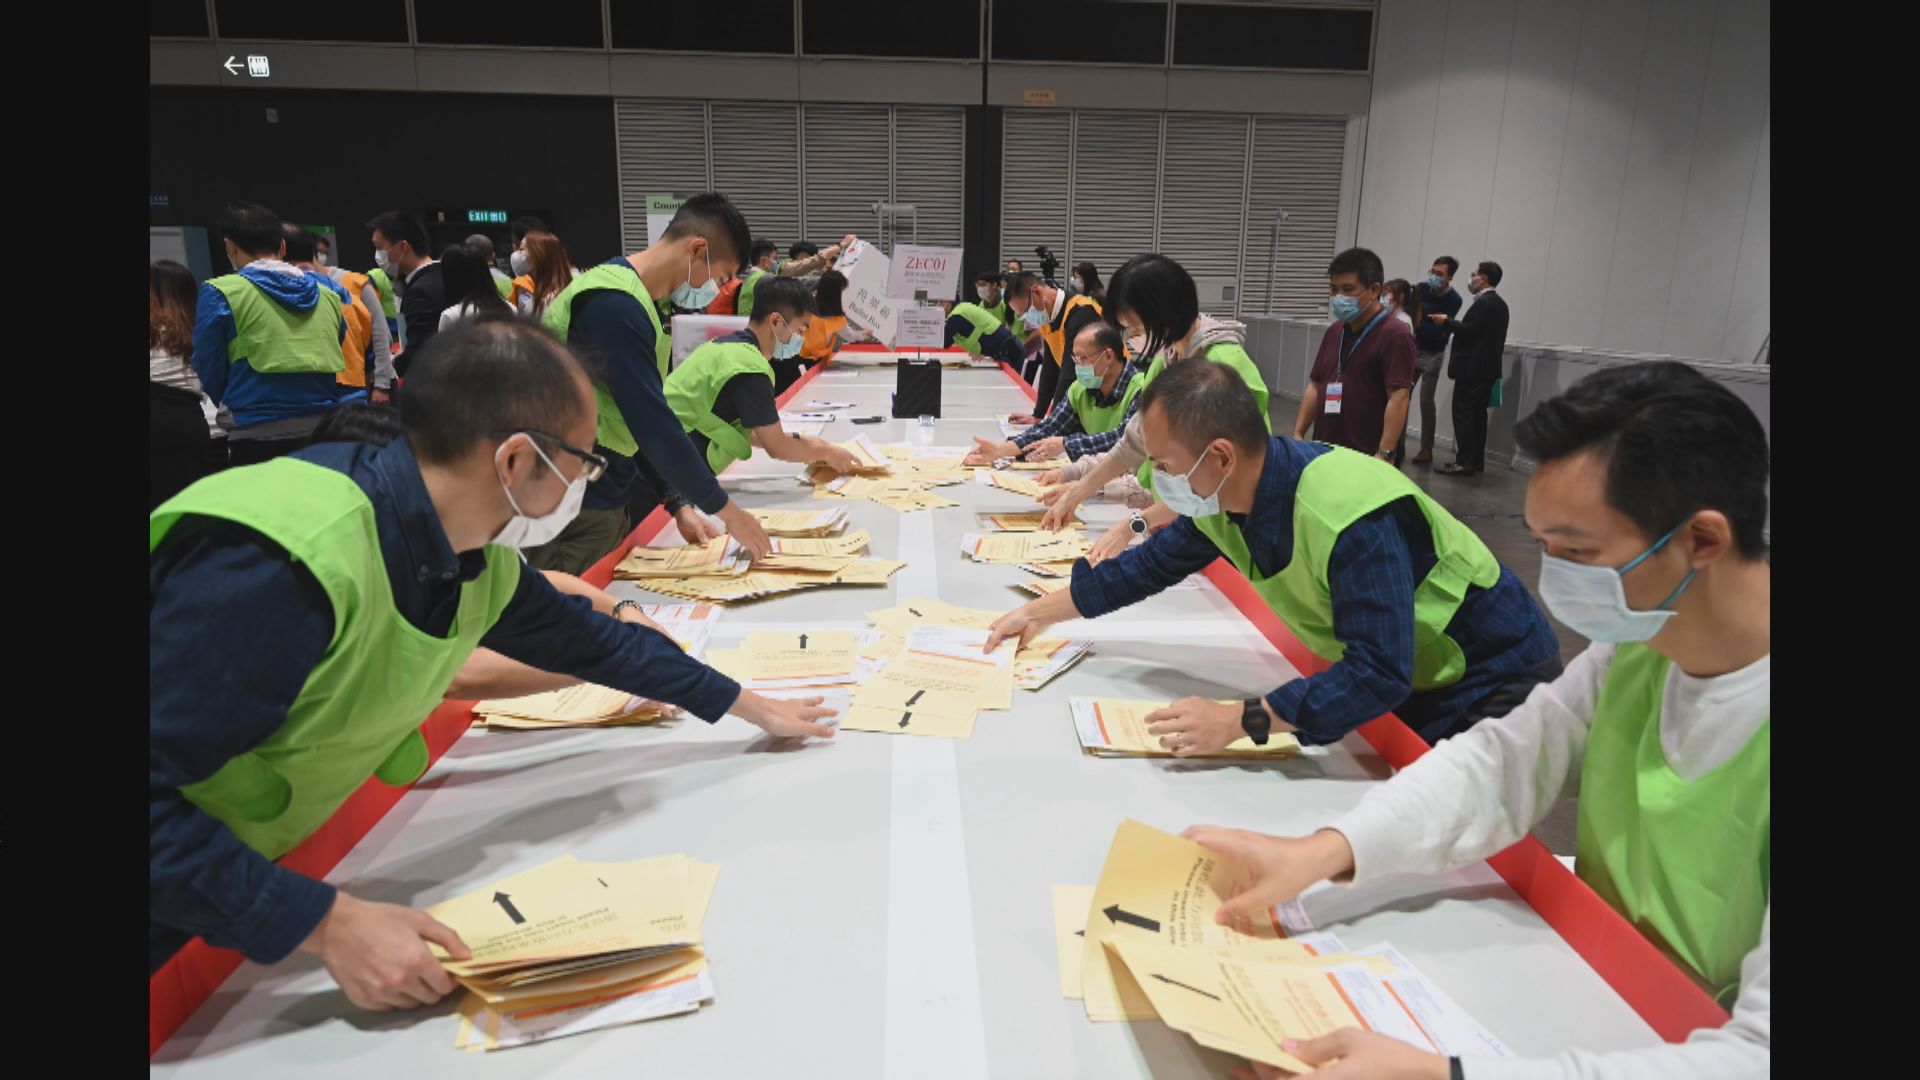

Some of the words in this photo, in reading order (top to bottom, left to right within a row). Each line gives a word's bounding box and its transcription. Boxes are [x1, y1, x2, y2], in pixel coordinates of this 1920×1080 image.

[468, 210, 488, 222] EXIT
[490, 211, 507, 223] 出口
[905, 255, 947, 272] ZEC01
[849, 301, 869, 321] Ballot
[868, 315, 880, 331] Box
